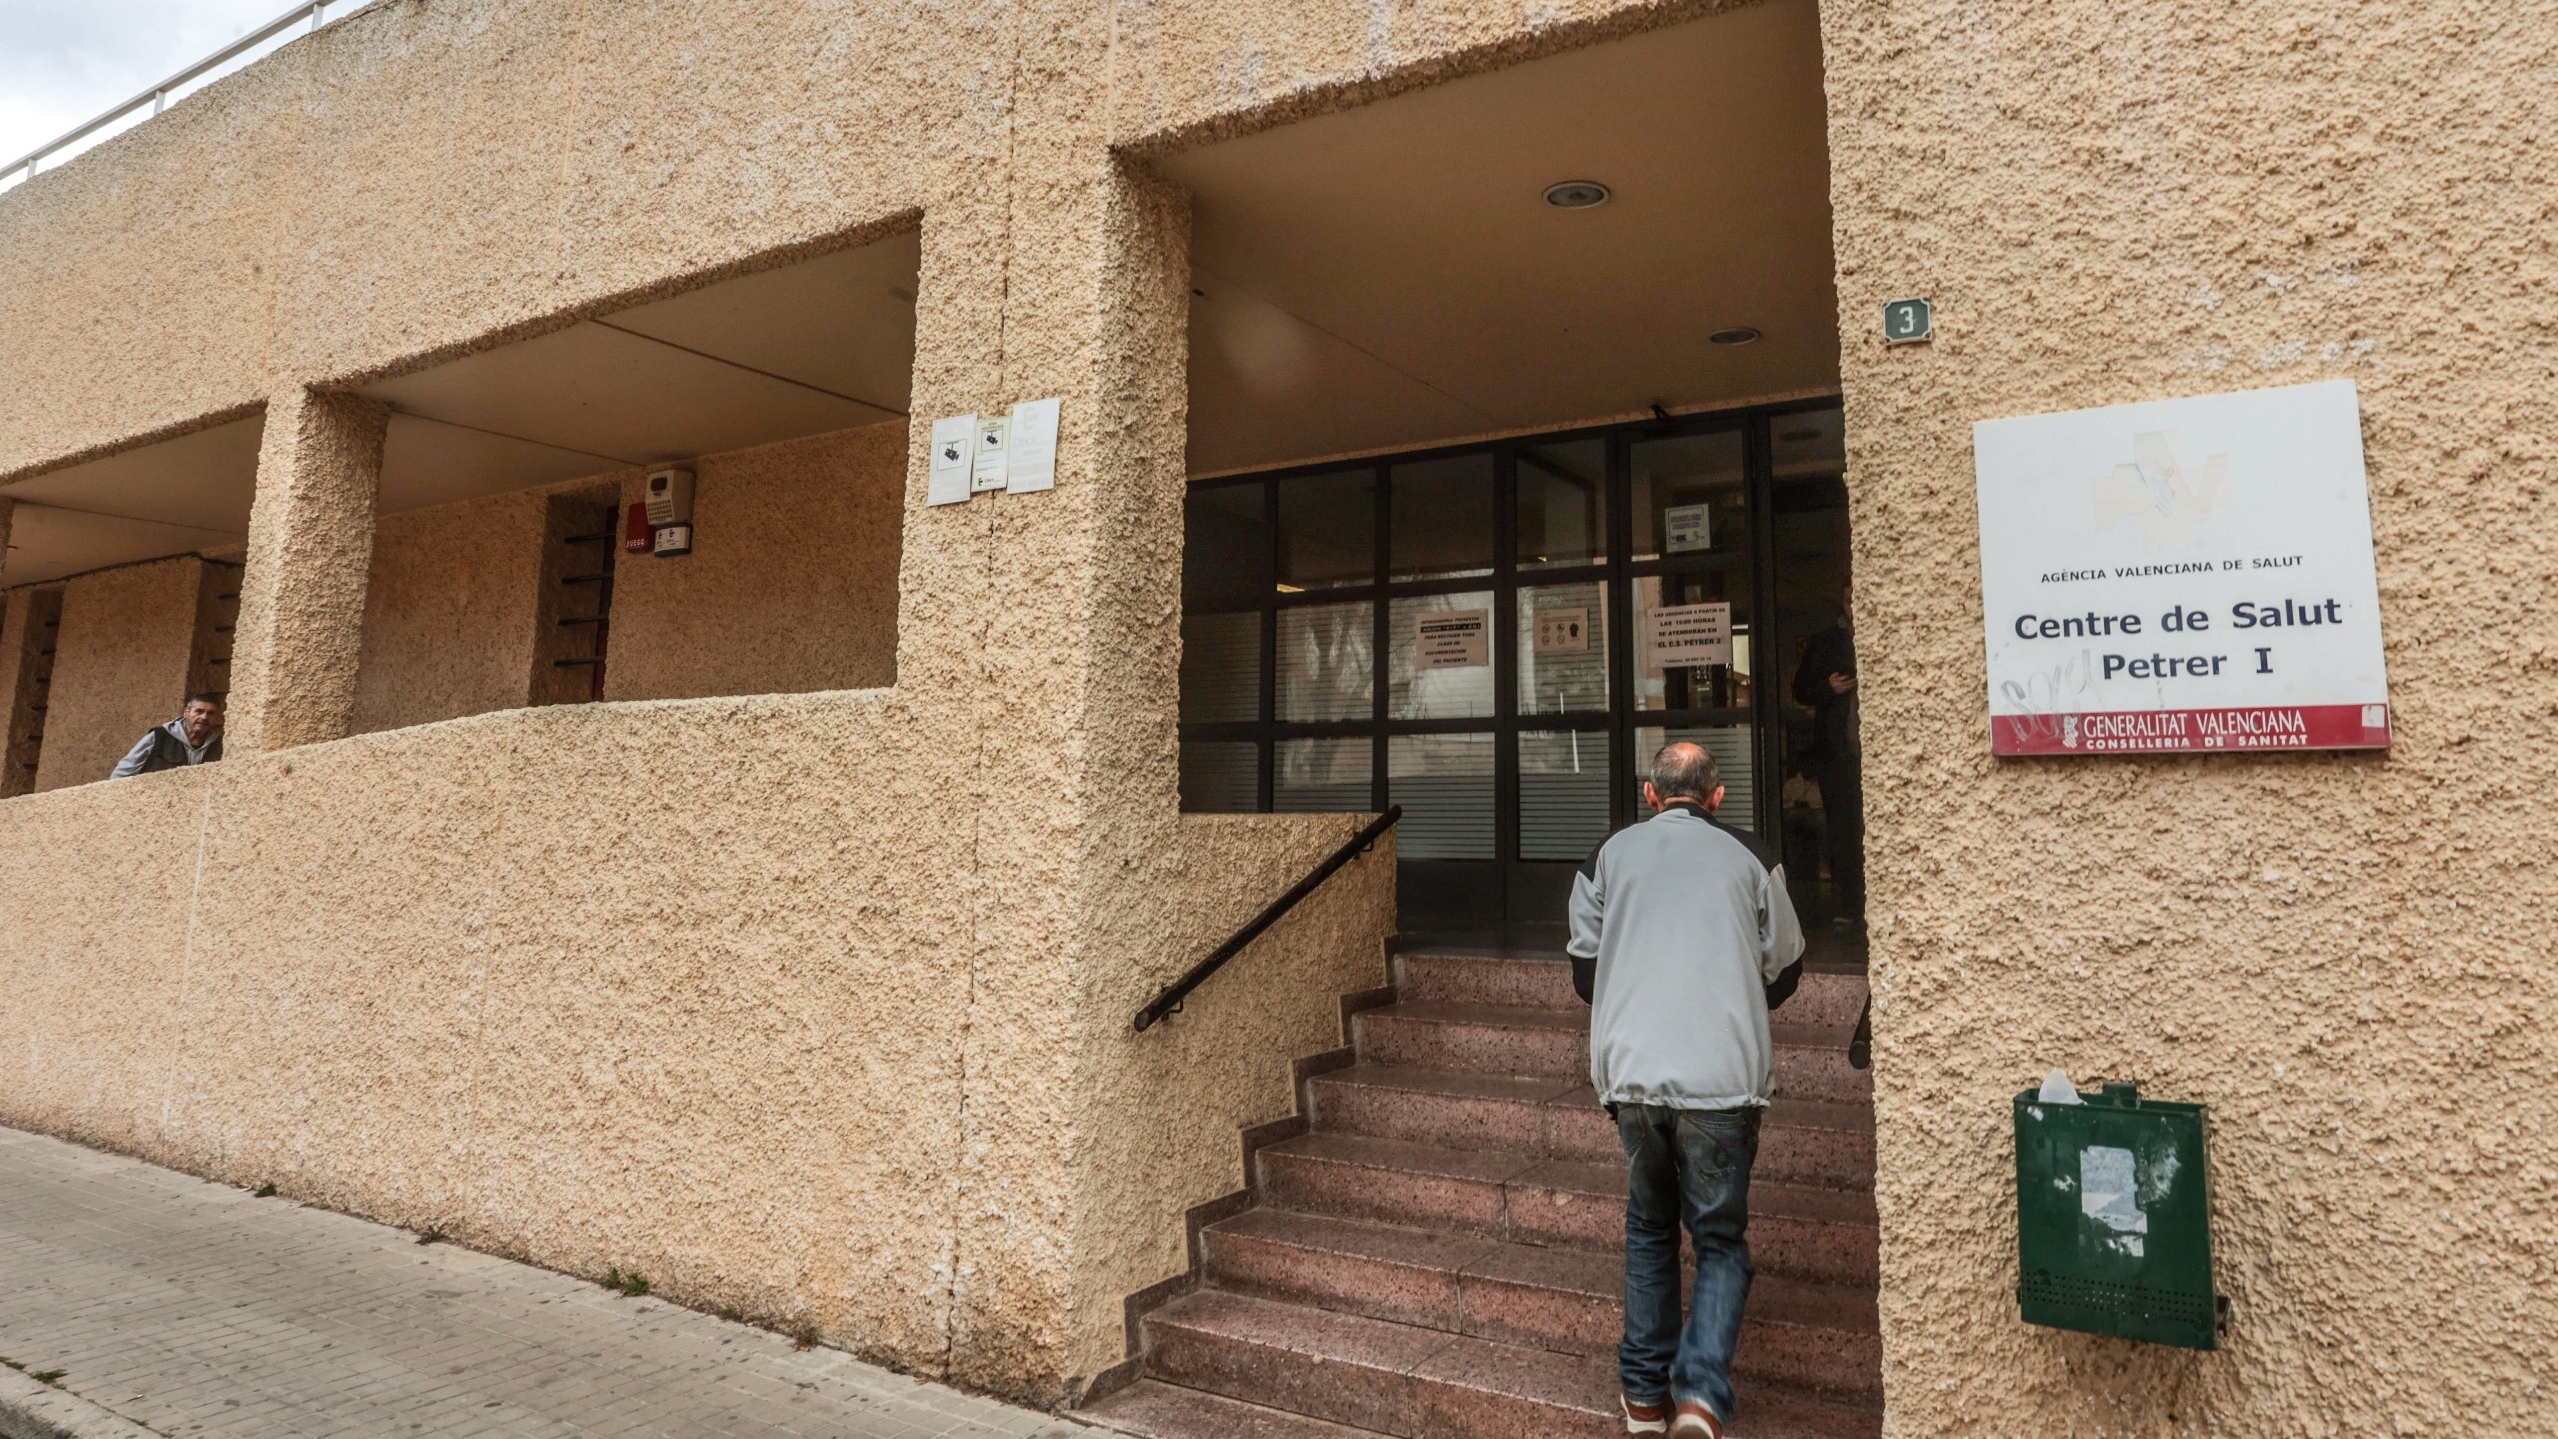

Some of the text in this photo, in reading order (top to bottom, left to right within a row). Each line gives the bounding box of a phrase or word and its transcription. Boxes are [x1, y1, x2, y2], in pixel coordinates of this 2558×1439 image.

[1900, 306, 1914, 334] 3
[626, 538, 645, 547] FUEGO
[2041, 555, 2304, 584] AGÈNCIA VALENCIANA DE SALUT
[2014, 598, 2342, 640] Centre de Salut
[2103, 648, 2274, 680] Petrer I
[2084, 710, 2306, 738] GENERALITAT VALENCIANA
[2086, 734, 2308, 749] CONSELLERIA DE SANITAT
